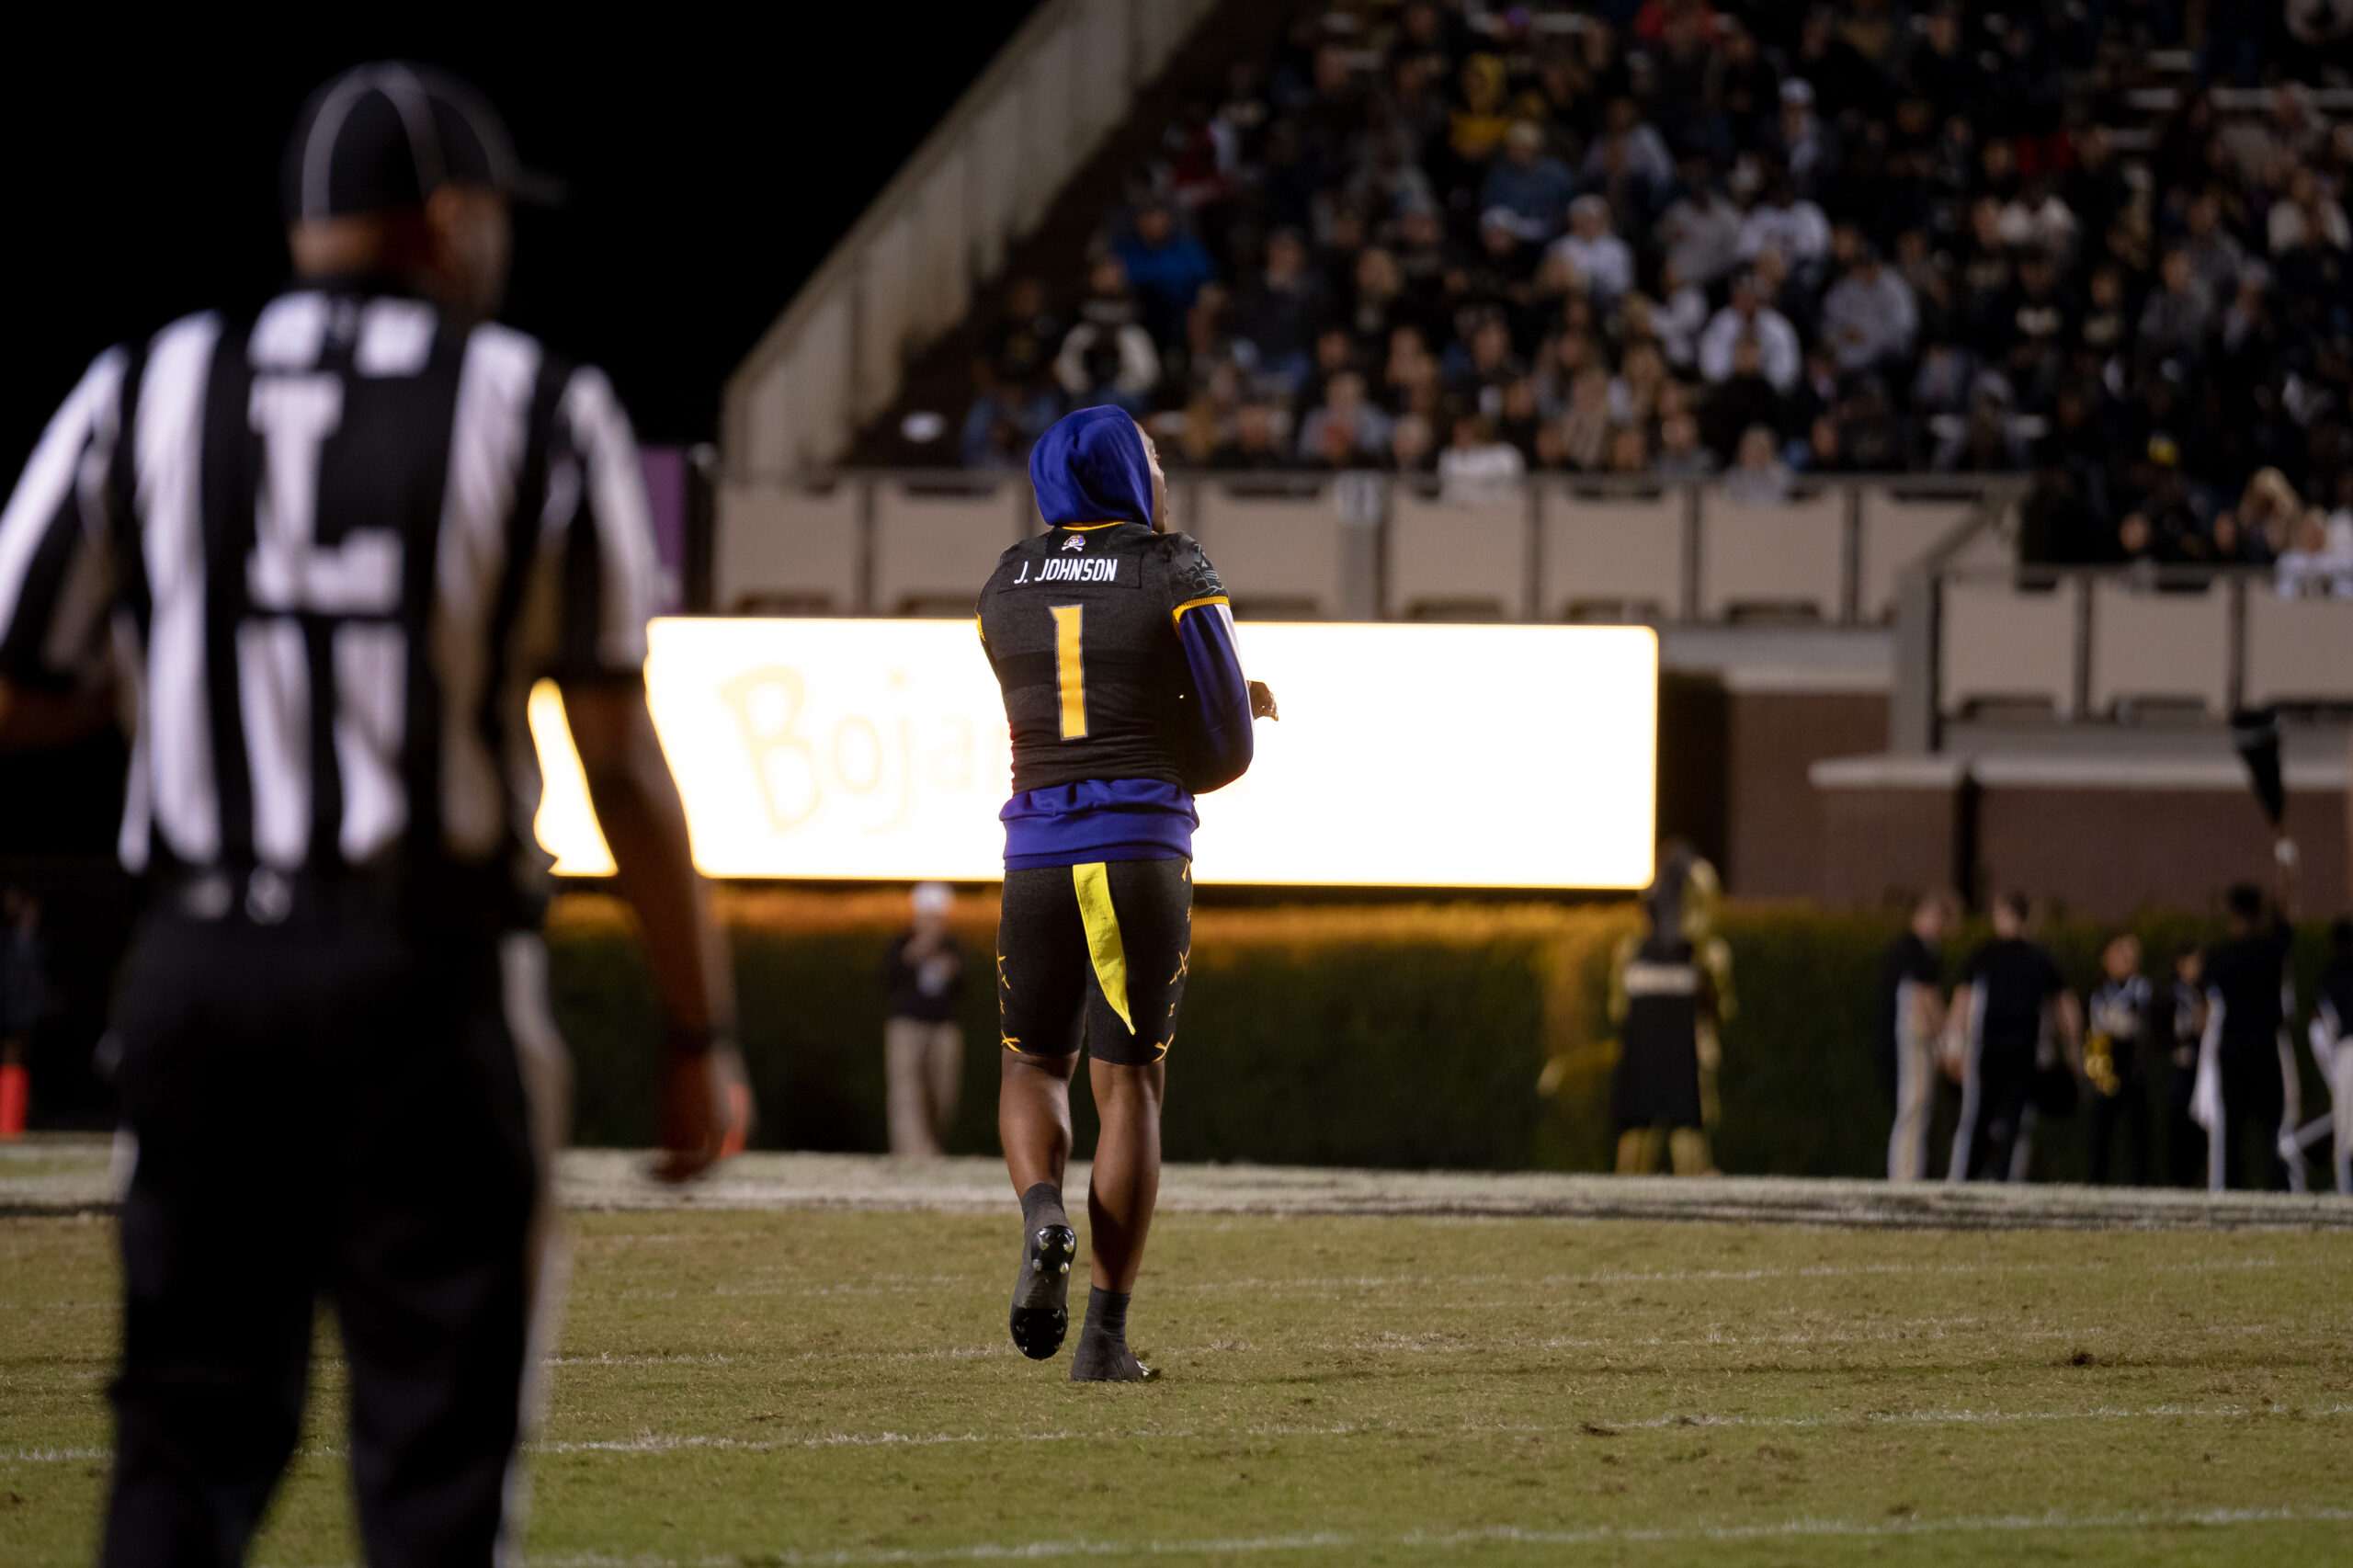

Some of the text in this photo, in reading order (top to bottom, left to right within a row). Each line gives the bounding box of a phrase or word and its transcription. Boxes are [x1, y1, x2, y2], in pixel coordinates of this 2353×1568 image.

[247, 372, 404, 616] L
[1013, 558, 1119, 585] J. JOHNSON
[1048, 603, 1088, 742] 1
